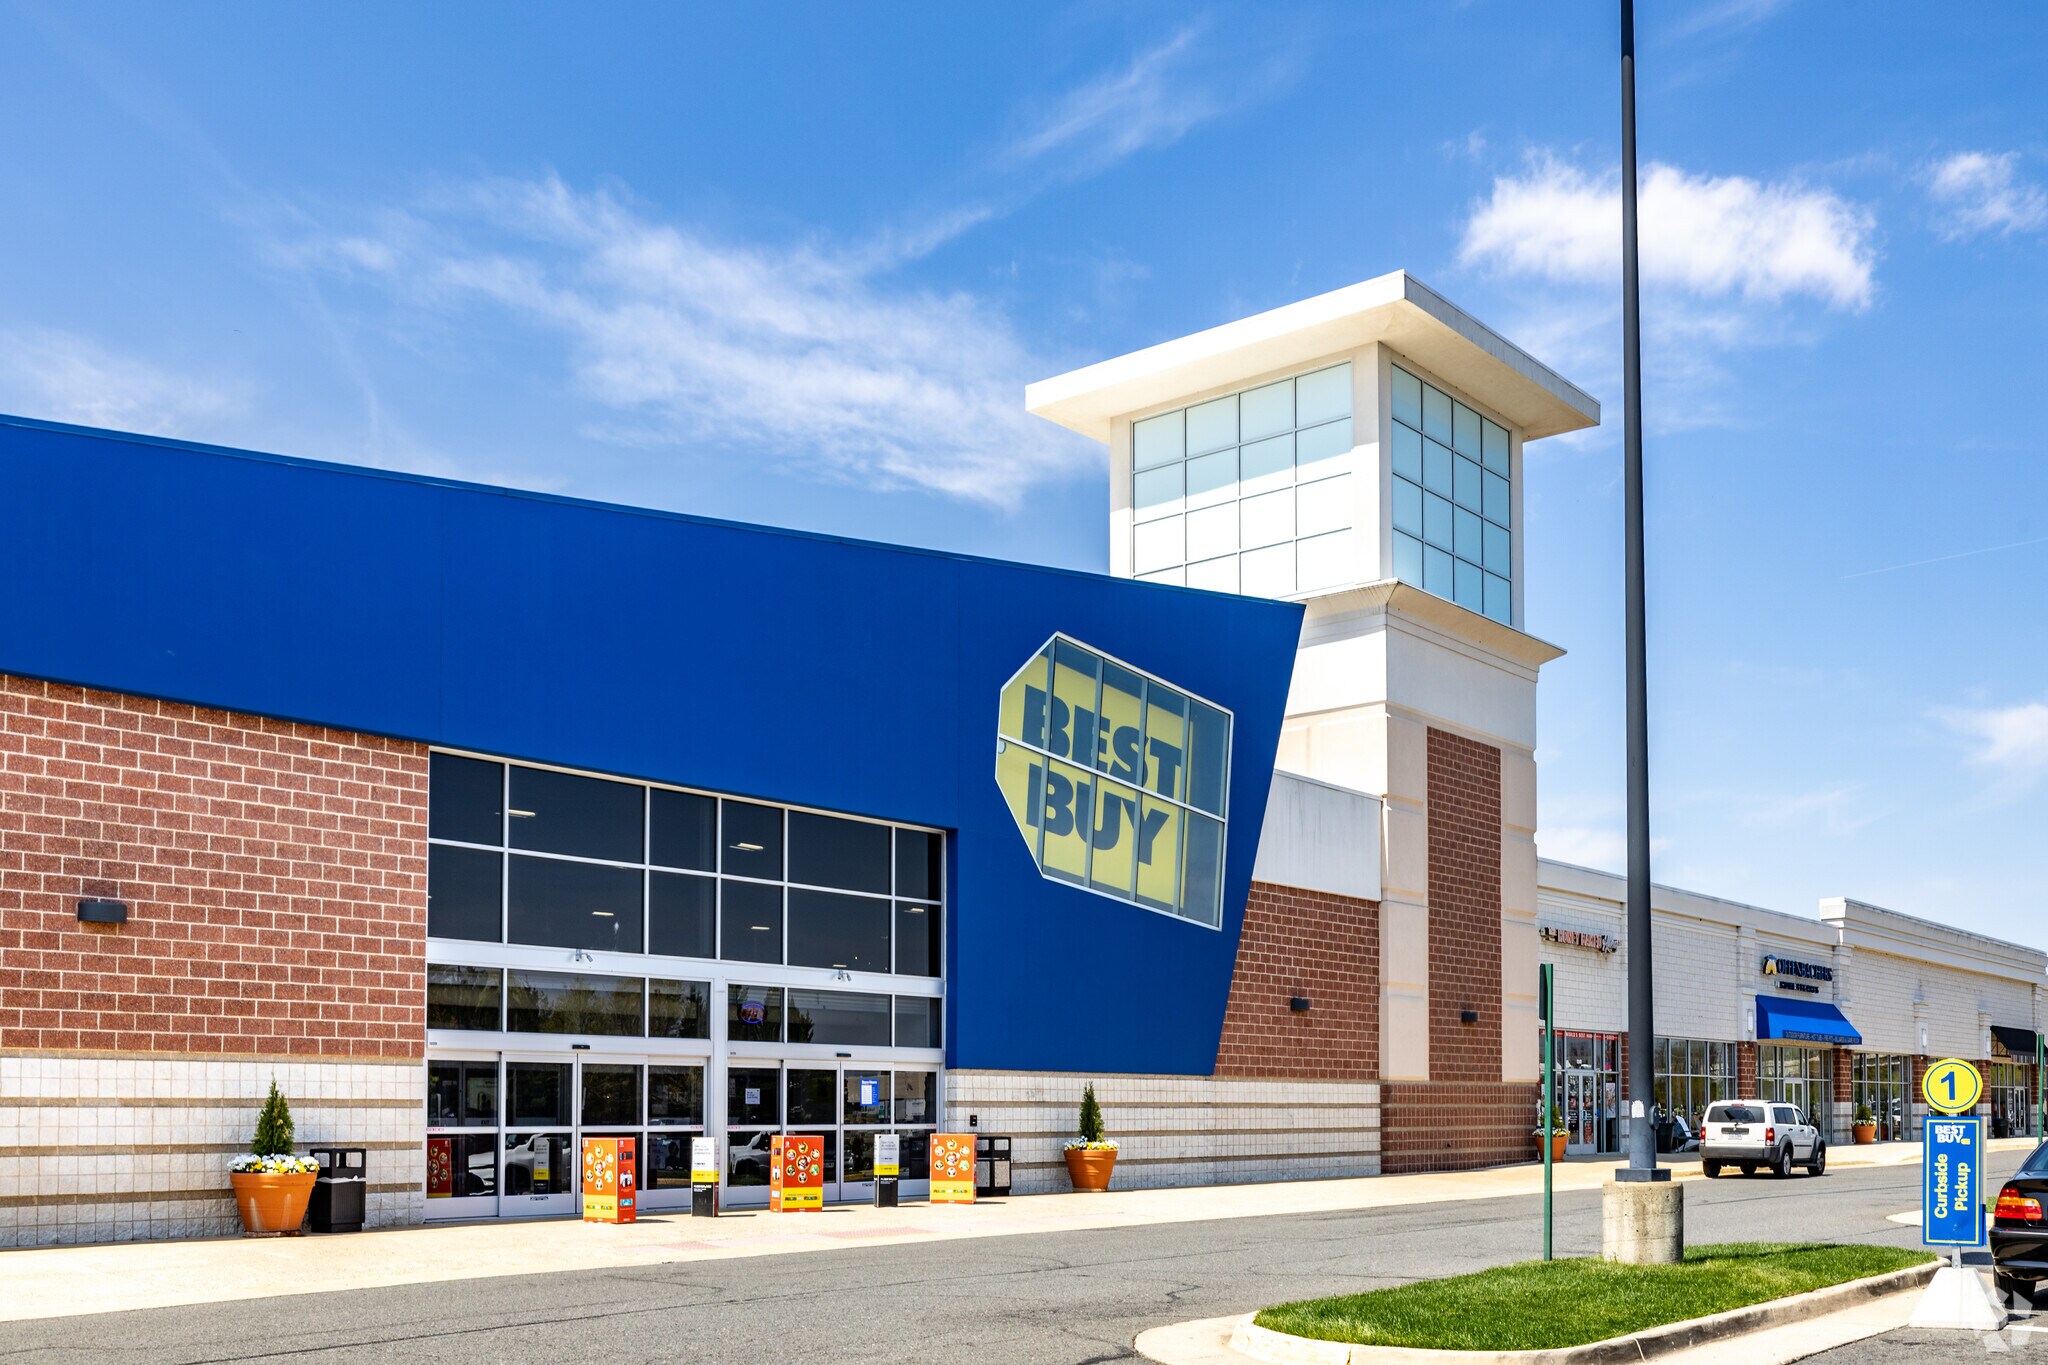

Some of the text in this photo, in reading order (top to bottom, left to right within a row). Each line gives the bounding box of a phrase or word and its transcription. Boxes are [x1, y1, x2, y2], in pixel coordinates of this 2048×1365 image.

[1022, 684, 1183, 798] BEST
[1026, 763, 1169, 866] BUY
[1940, 1071, 1956, 1101] 1
[1935, 1125, 1966, 1134] BEST
[1937, 1134, 1963, 1144] BUY
[1934, 1153, 1948, 1219] Curbside
[1954, 1162, 1971, 1211] Pickup
